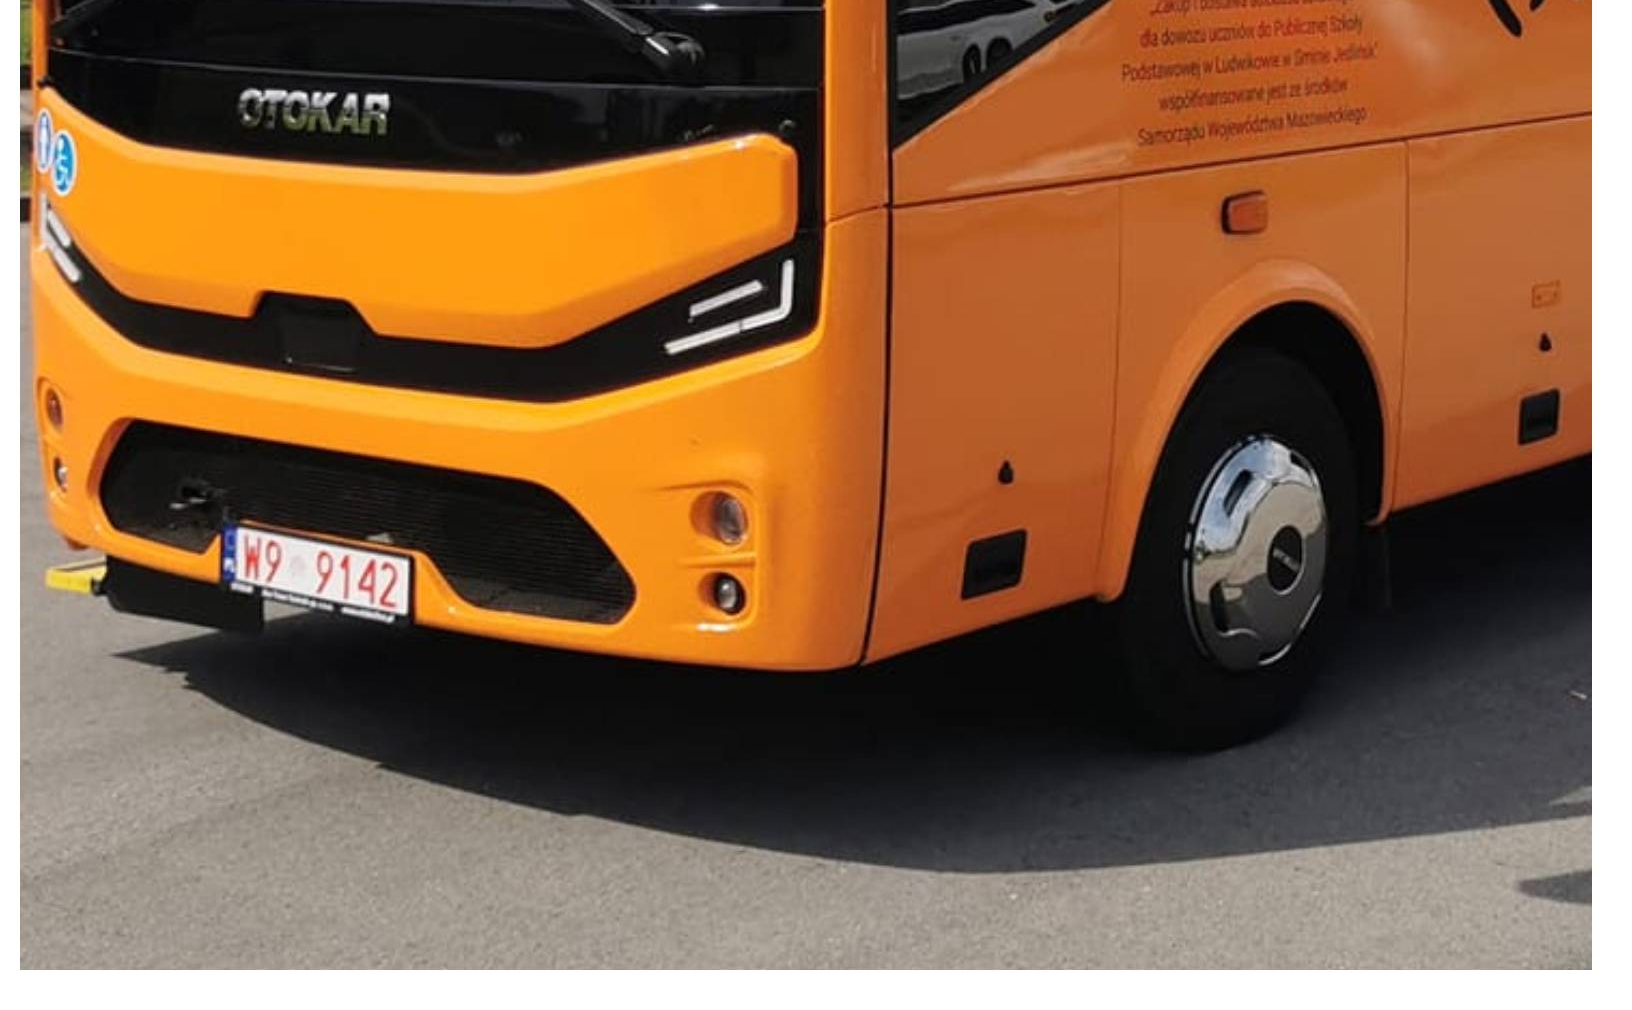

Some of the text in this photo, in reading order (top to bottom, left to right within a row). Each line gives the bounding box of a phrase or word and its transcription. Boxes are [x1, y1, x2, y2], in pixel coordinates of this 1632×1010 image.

[1139, 29, 1159, 48] dla
[1257, 21, 1272, 39] do
[1273, 17, 1328, 42] Publicznej
[1121, 60, 1201, 82] Podstawowej
[239, 88, 390, 135] OTOKAR
[243, 533, 283, 584] W9
[315, 549, 397, 609] 9142
